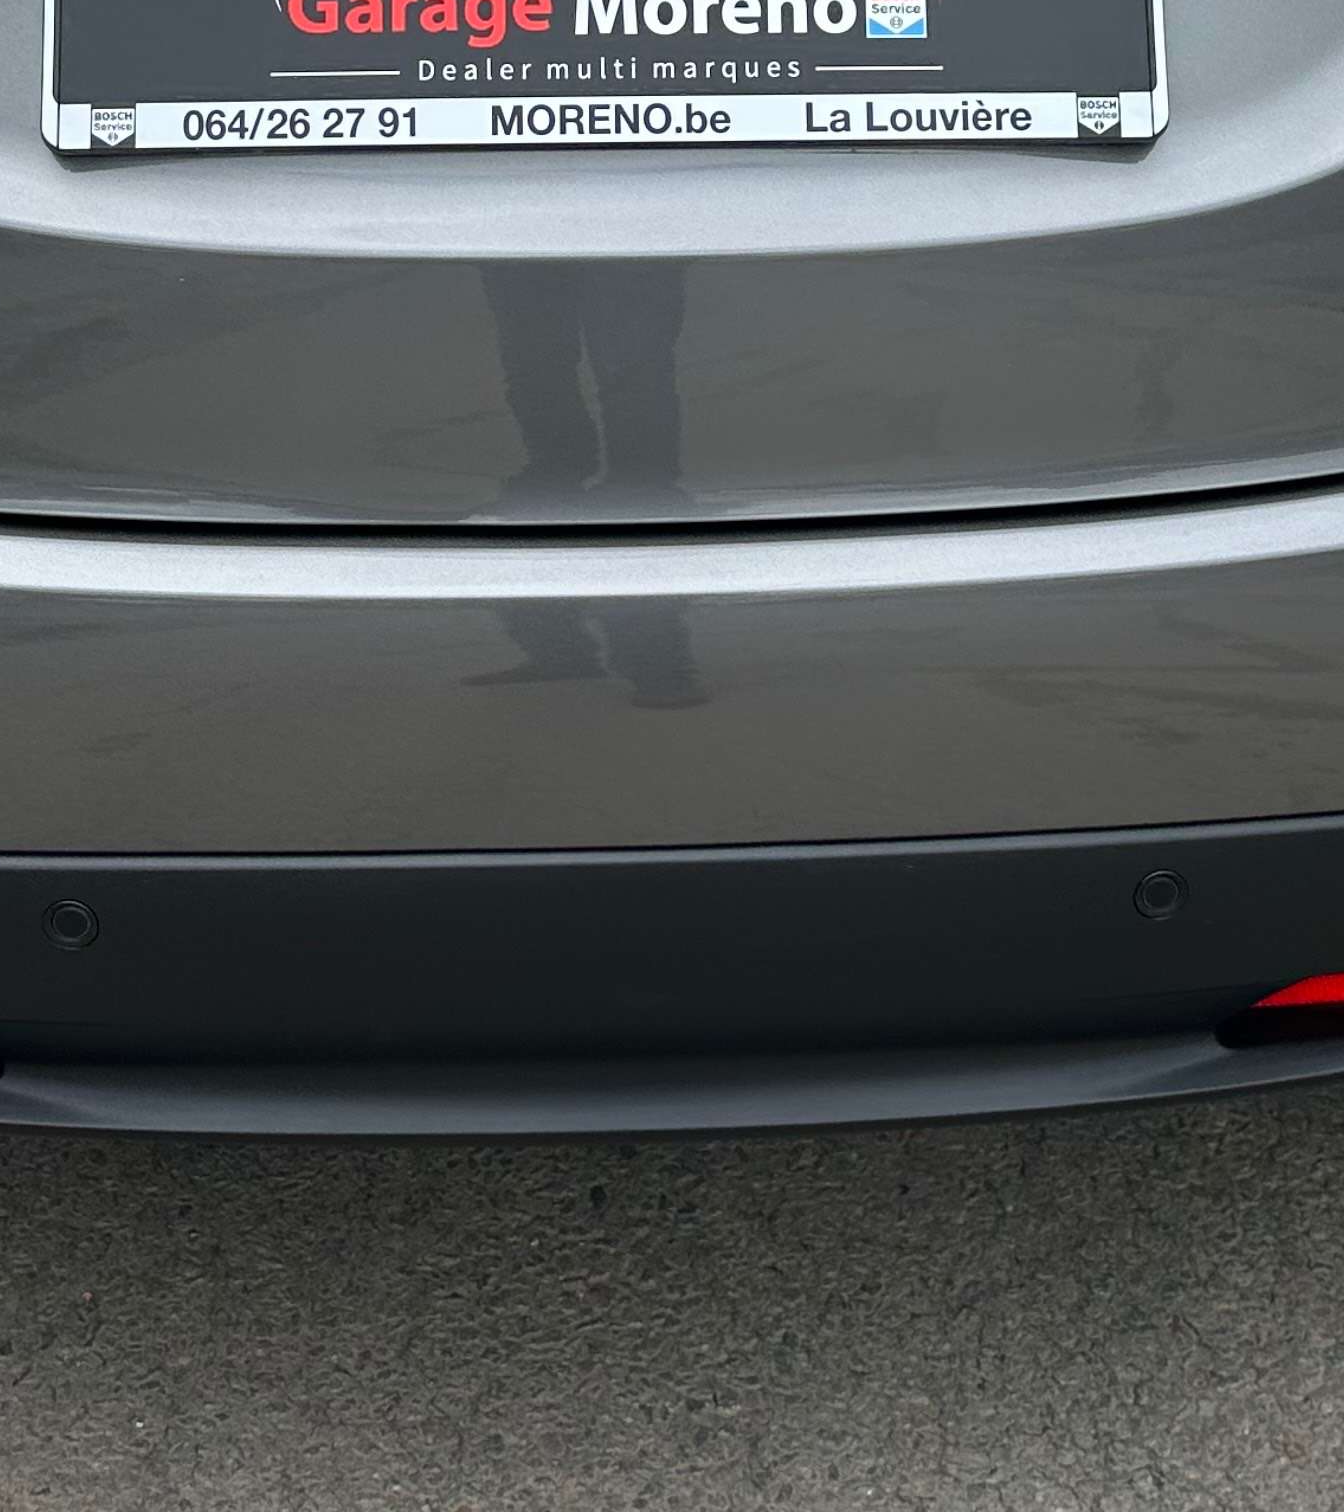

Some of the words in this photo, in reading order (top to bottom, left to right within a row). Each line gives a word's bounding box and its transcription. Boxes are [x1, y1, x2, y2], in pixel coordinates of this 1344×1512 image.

[871, 2, 921, 14] Service
[418, 57, 532, 81] Dealer
[546, 55, 636, 80] multi
[653, 55, 800, 84] marques
[1080, 100, 1117, 109] BOSCH
[94, 111, 133, 121] BOSCH
[182, 107, 311, 141] 064/26
[322, 107, 365, 138] 27
[378, 107, 416, 138] 91
[491, 102, 731, 136] MORENO.be
[806, 102, 851, 133] La
[866, 100, 1032, 132] Louvière
[93, 122, 133, 131] Service
